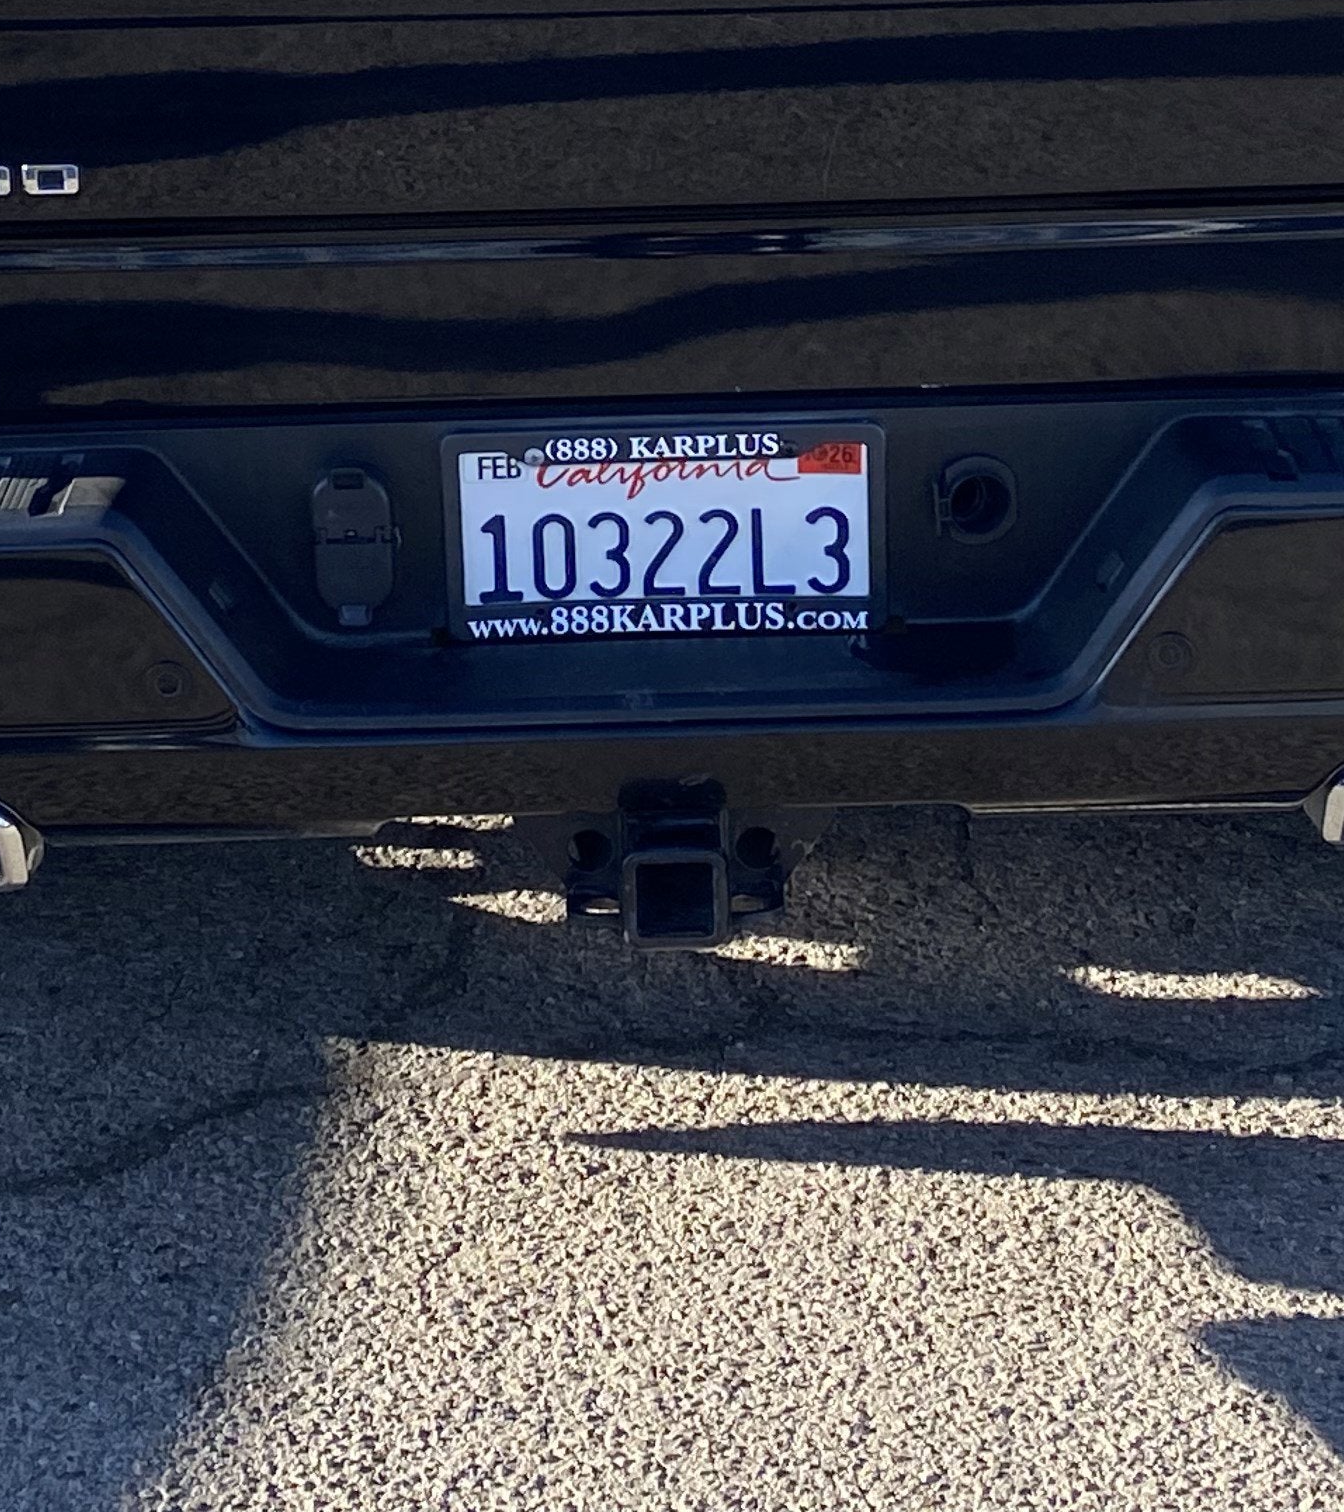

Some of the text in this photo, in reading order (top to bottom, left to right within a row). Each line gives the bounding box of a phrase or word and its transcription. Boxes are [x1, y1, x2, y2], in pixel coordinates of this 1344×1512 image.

[545, 432, 780, 461] (888) KARPLUS
[829, 445, 853, 463] 26
[477, 456, 522, 480] FEB
[536, 456, 801, 500] California
[479, 505, 852, 604] 10322L3
